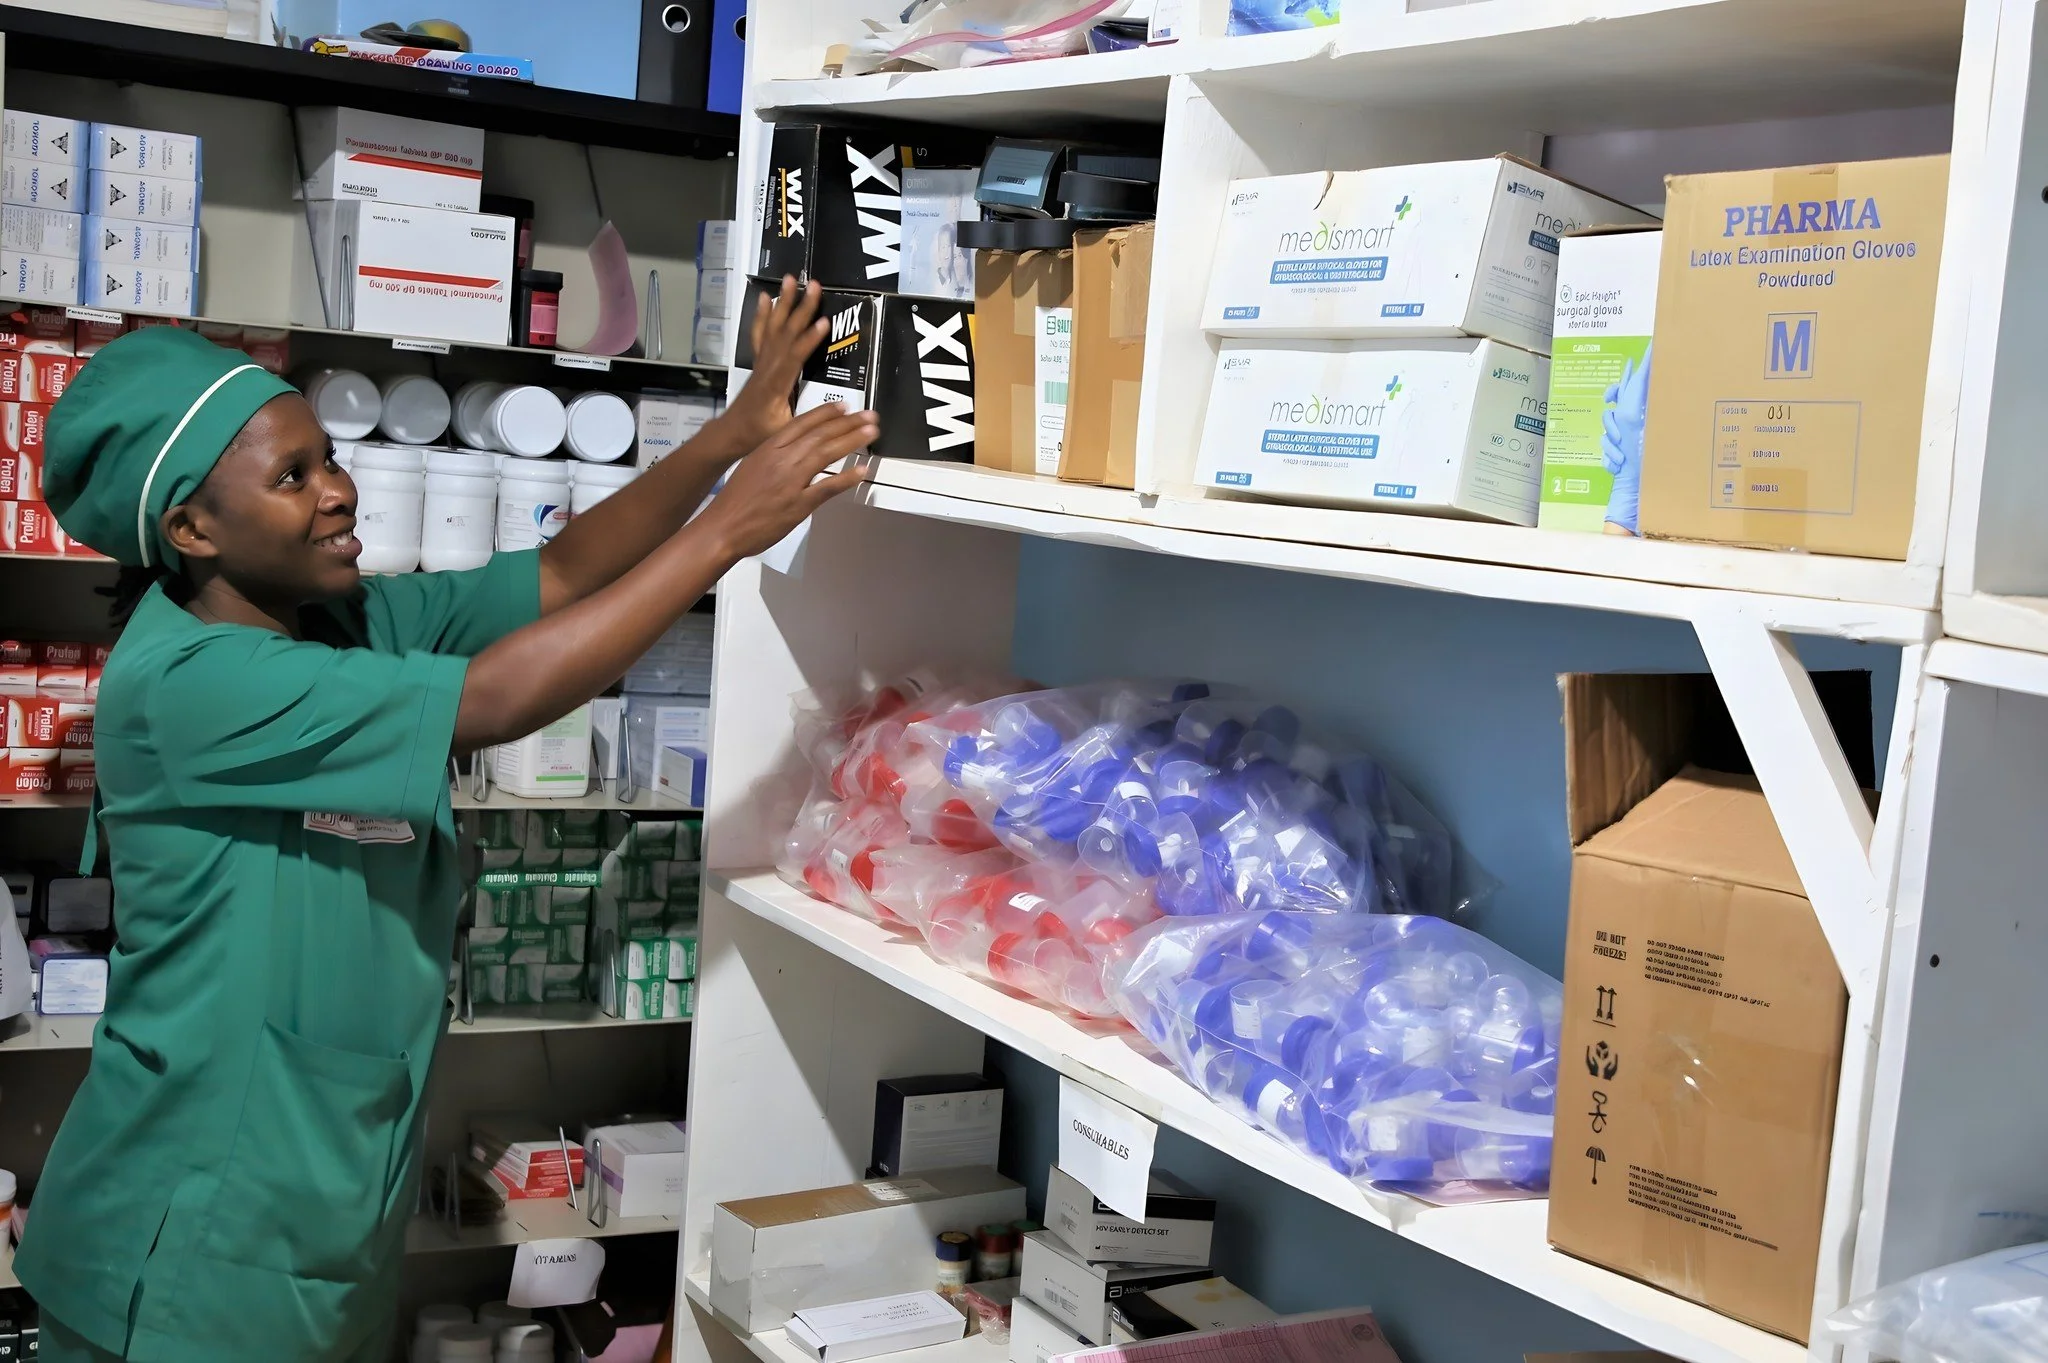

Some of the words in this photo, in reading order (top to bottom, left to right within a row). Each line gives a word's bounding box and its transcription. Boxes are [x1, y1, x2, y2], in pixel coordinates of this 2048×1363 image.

[417, 56, 472, 72] DRAWING
[477, 64, 519, 76] BOARD
[786, 167, 805, 238] WIX
[846, 144, 902, 280] WIX
[1723, 197, 1881, 237] PHARMA
[1277, 221, 1396, 252] medismart
[1738, 243, 1846, 265] Examination
[1852, 240, 1917, 260] Gloves
[831, 301, 863, 343] WIX
[1556, 304, 1592, 318] surgical
[1593, 304, 1623, 318] gloves
[1769, 318, 1812, 372] M
[911, 311, 976, 452] WIX
[1269, 395, 1386, 427] medismart
[1609, 931, 1627, 946] NOT
